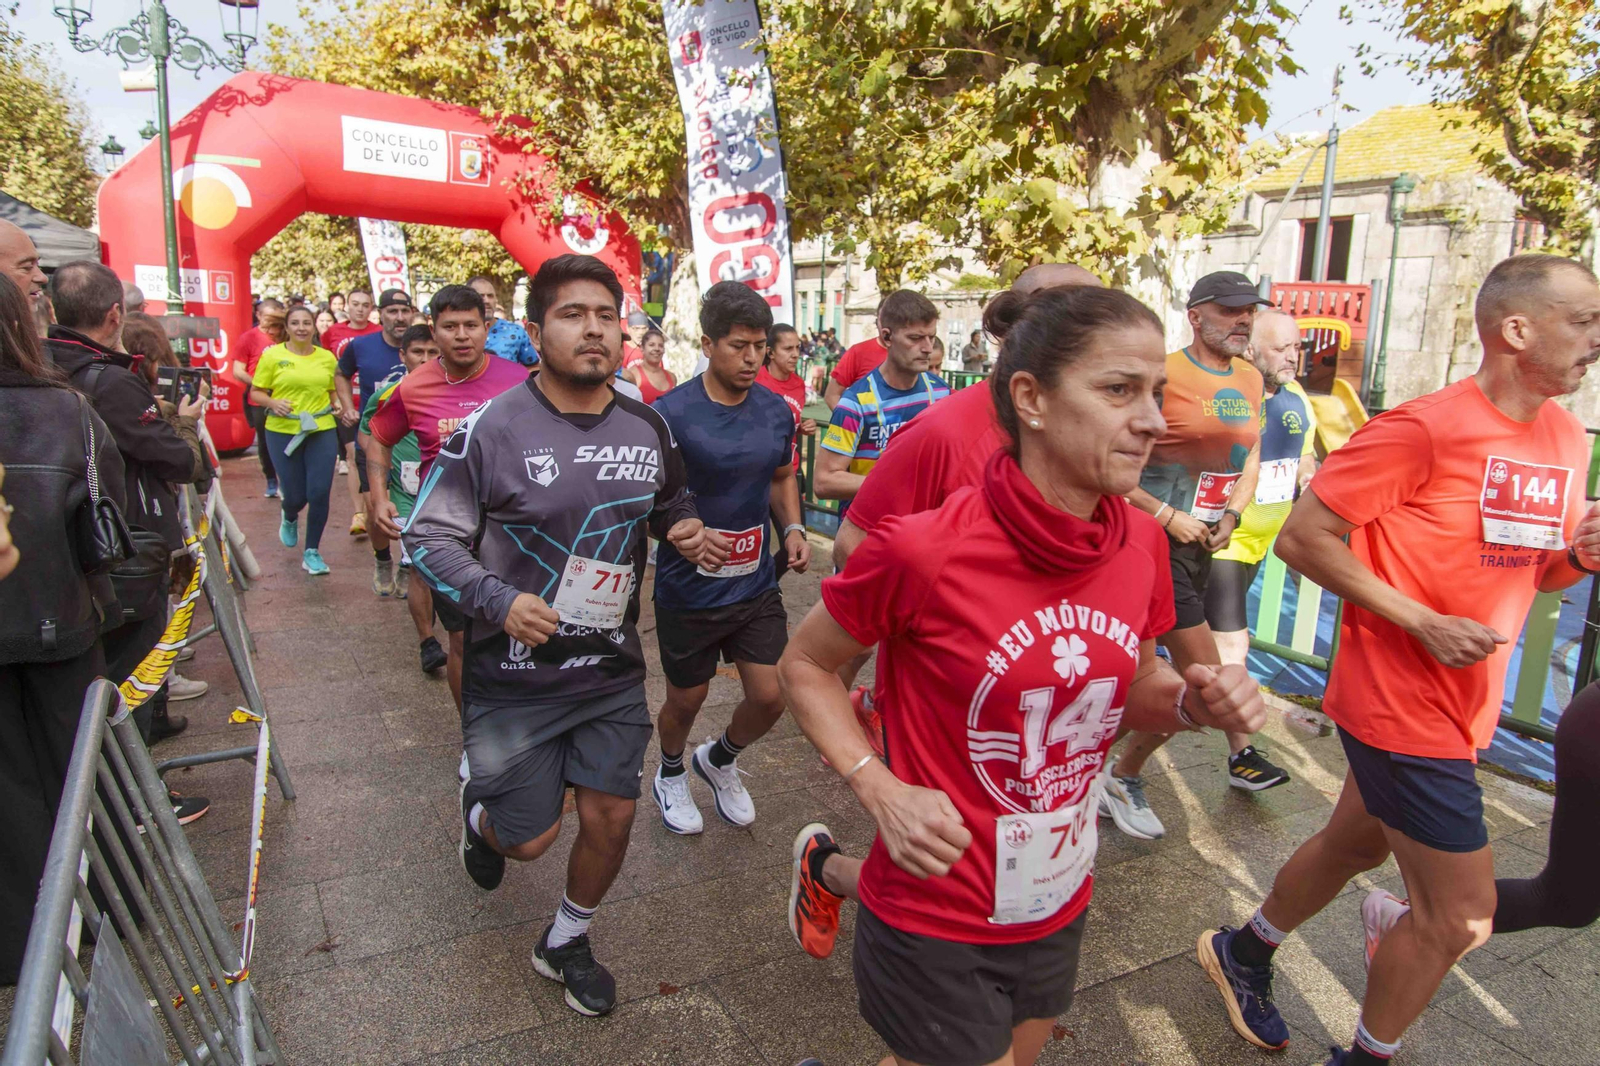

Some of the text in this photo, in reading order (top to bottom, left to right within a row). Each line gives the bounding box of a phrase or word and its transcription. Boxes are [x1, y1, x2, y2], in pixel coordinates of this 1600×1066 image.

[706, 19, 750, 39] CONCELLO
[710, 30, 747, 46] DE VIGO
[694, 78, 721, 180] deporte
[352, 128, 439, 152] CONCELLO
[363, 147, 429, 167] DE VIGO
[148, 284, 162, 292] DE
[1204, 407, 1219, 417] DE
[573, 445, 658, 466] SANTA
[596, 463, 659, 483] CRUZ
[1511, 474, 1558, 506] 144
[985, 598, 1140, 676] #EU MÓVOME
[500, 661, 537, 670] onza
[1018, 676, 1118, 779] 14
